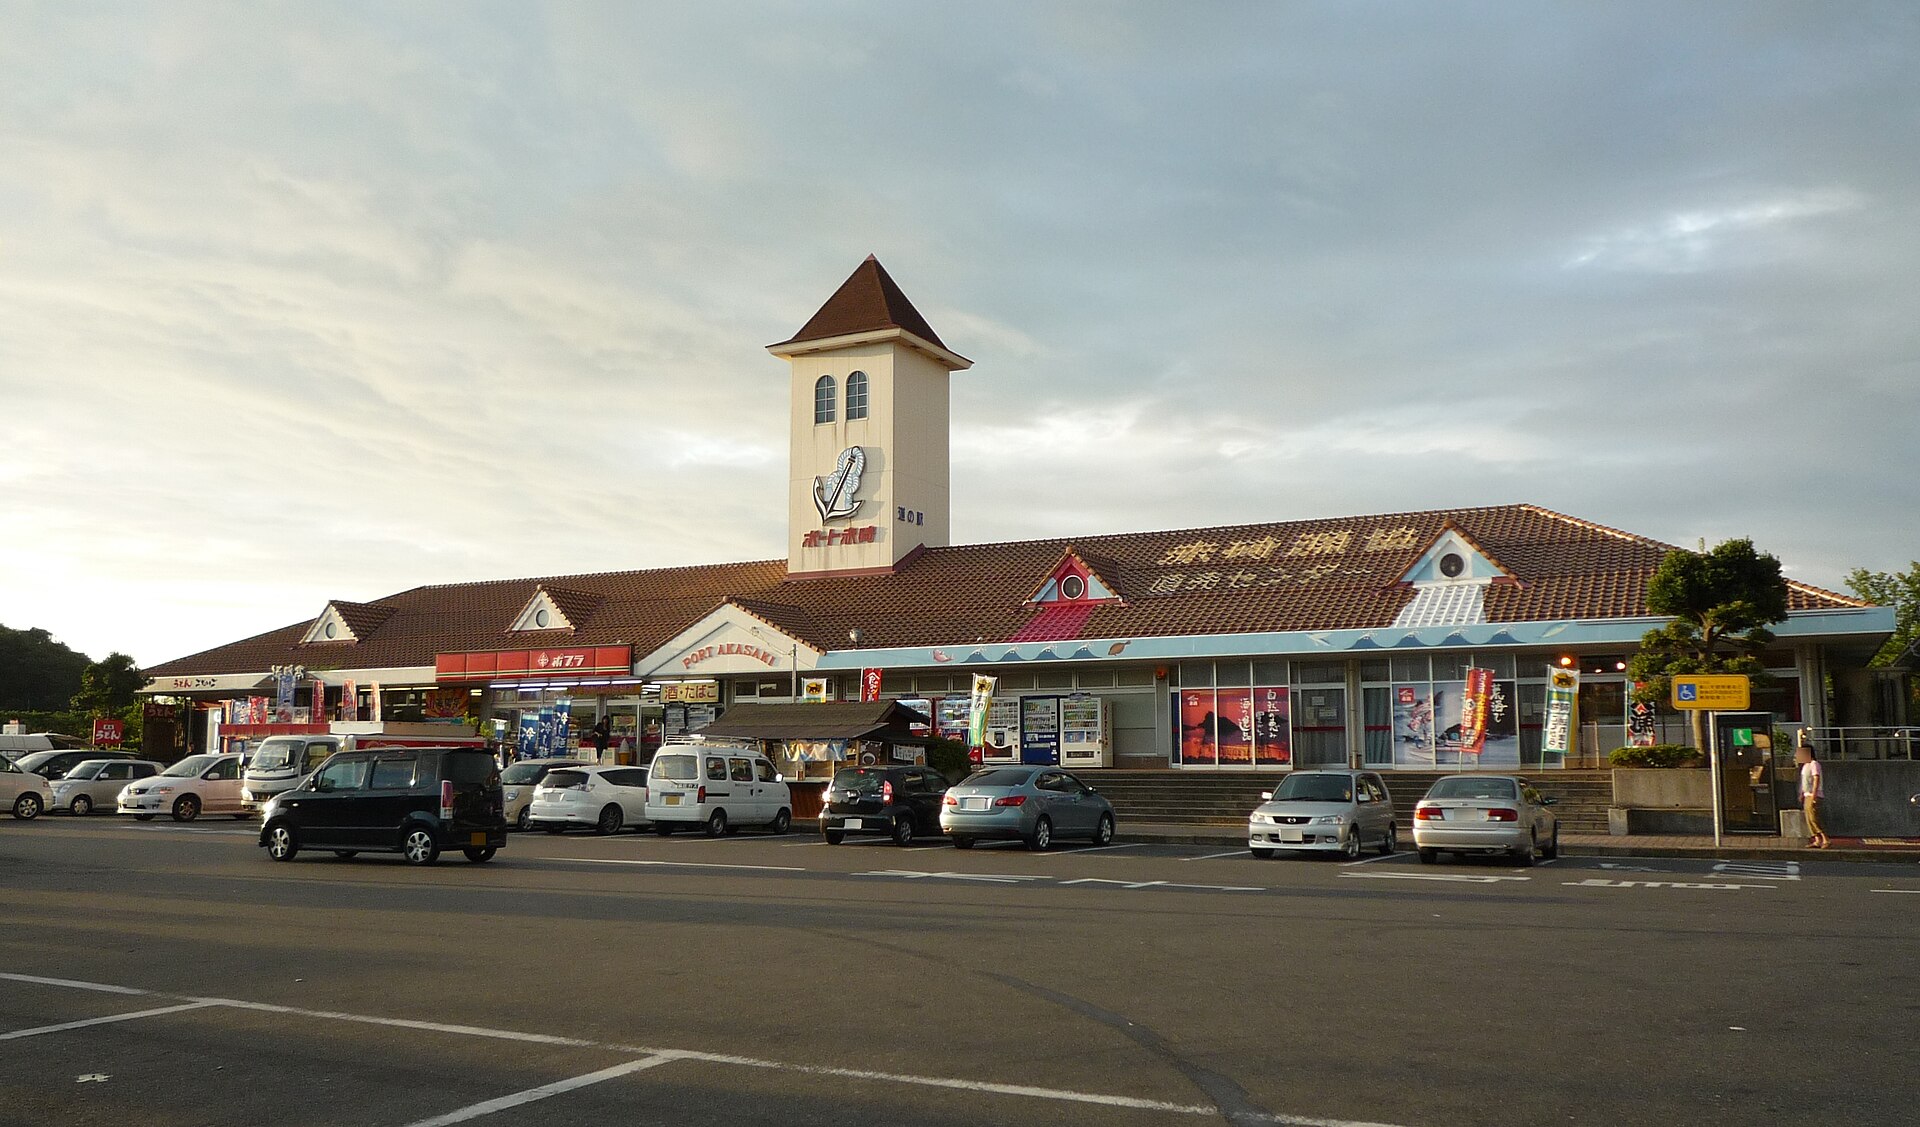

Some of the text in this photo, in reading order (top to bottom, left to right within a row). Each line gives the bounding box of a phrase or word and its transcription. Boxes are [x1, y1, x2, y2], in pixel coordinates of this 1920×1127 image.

[897, 506, 924, 526] 道の駅
[551, 653, 585, 667] ポプラ
[682, 643, 776, 669] PORT AKASAKI
[173, 678, 192, 689] うどん
[664, 684, 717, 700] 酒・たばこ
[96, 730, 121, 740] うどん
